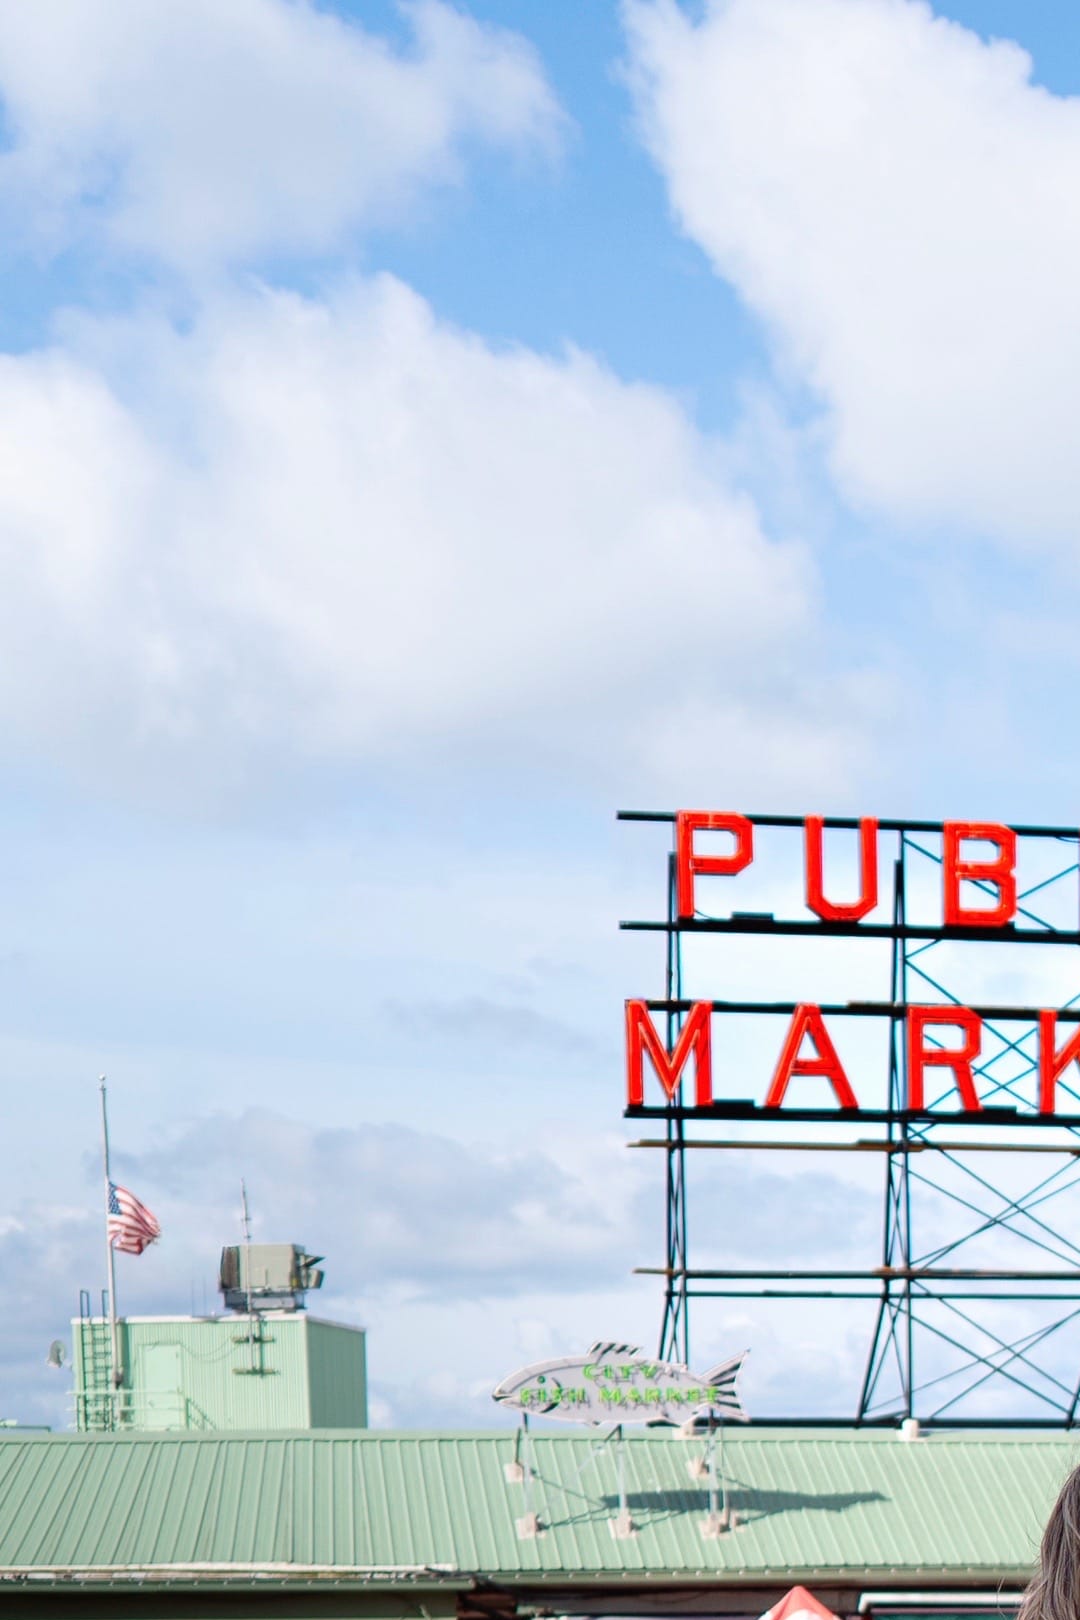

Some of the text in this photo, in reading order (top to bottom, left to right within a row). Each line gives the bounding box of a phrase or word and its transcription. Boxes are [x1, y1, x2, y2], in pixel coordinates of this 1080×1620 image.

[582, 1363, 659, 1381] CITY
[518, 1386, 720, 1405] FISH MARKET
